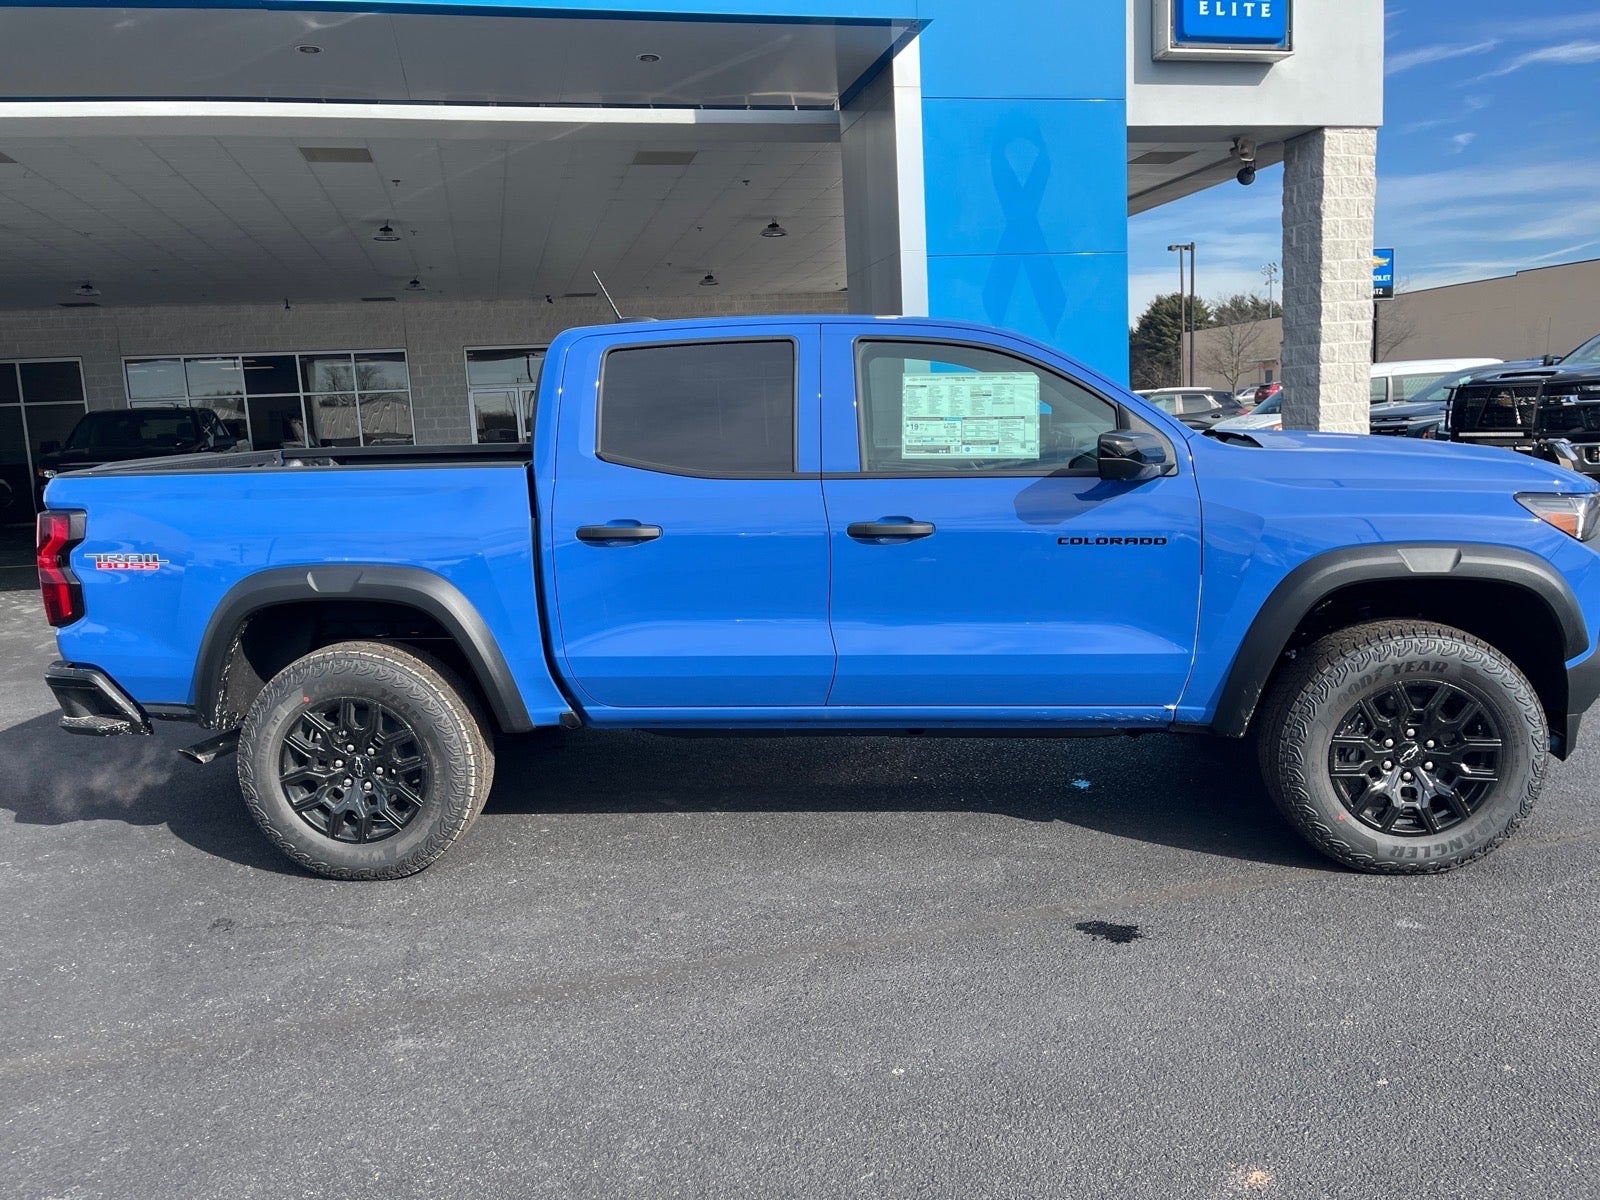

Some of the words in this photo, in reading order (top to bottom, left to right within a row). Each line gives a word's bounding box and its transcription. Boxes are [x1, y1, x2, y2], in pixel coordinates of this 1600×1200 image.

[1199, 1, 1271, 18] ELITE
[1057, 537, 1168, 546] COLORADO
[84, 553, 169, 563] TRAIL
[96, 562, 159, 570] BOSS
